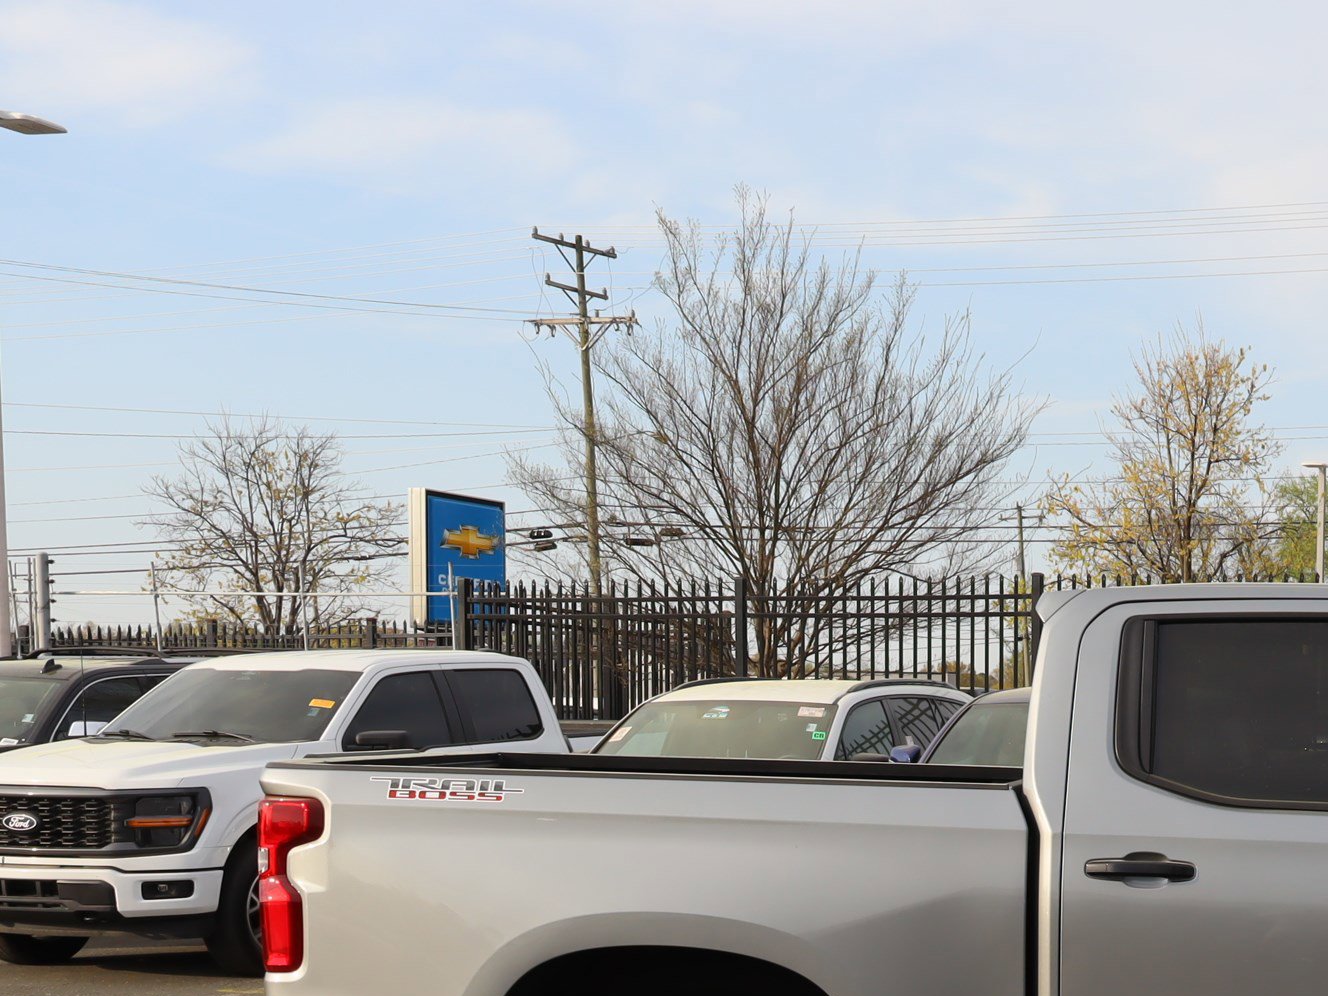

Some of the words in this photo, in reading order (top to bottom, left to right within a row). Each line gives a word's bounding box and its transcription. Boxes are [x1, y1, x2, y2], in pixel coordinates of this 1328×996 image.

[370, 776, 525, 794] TRAIL
[387, 789, 505, 803] BOSS
[8, 816, 31, 828] Ford
